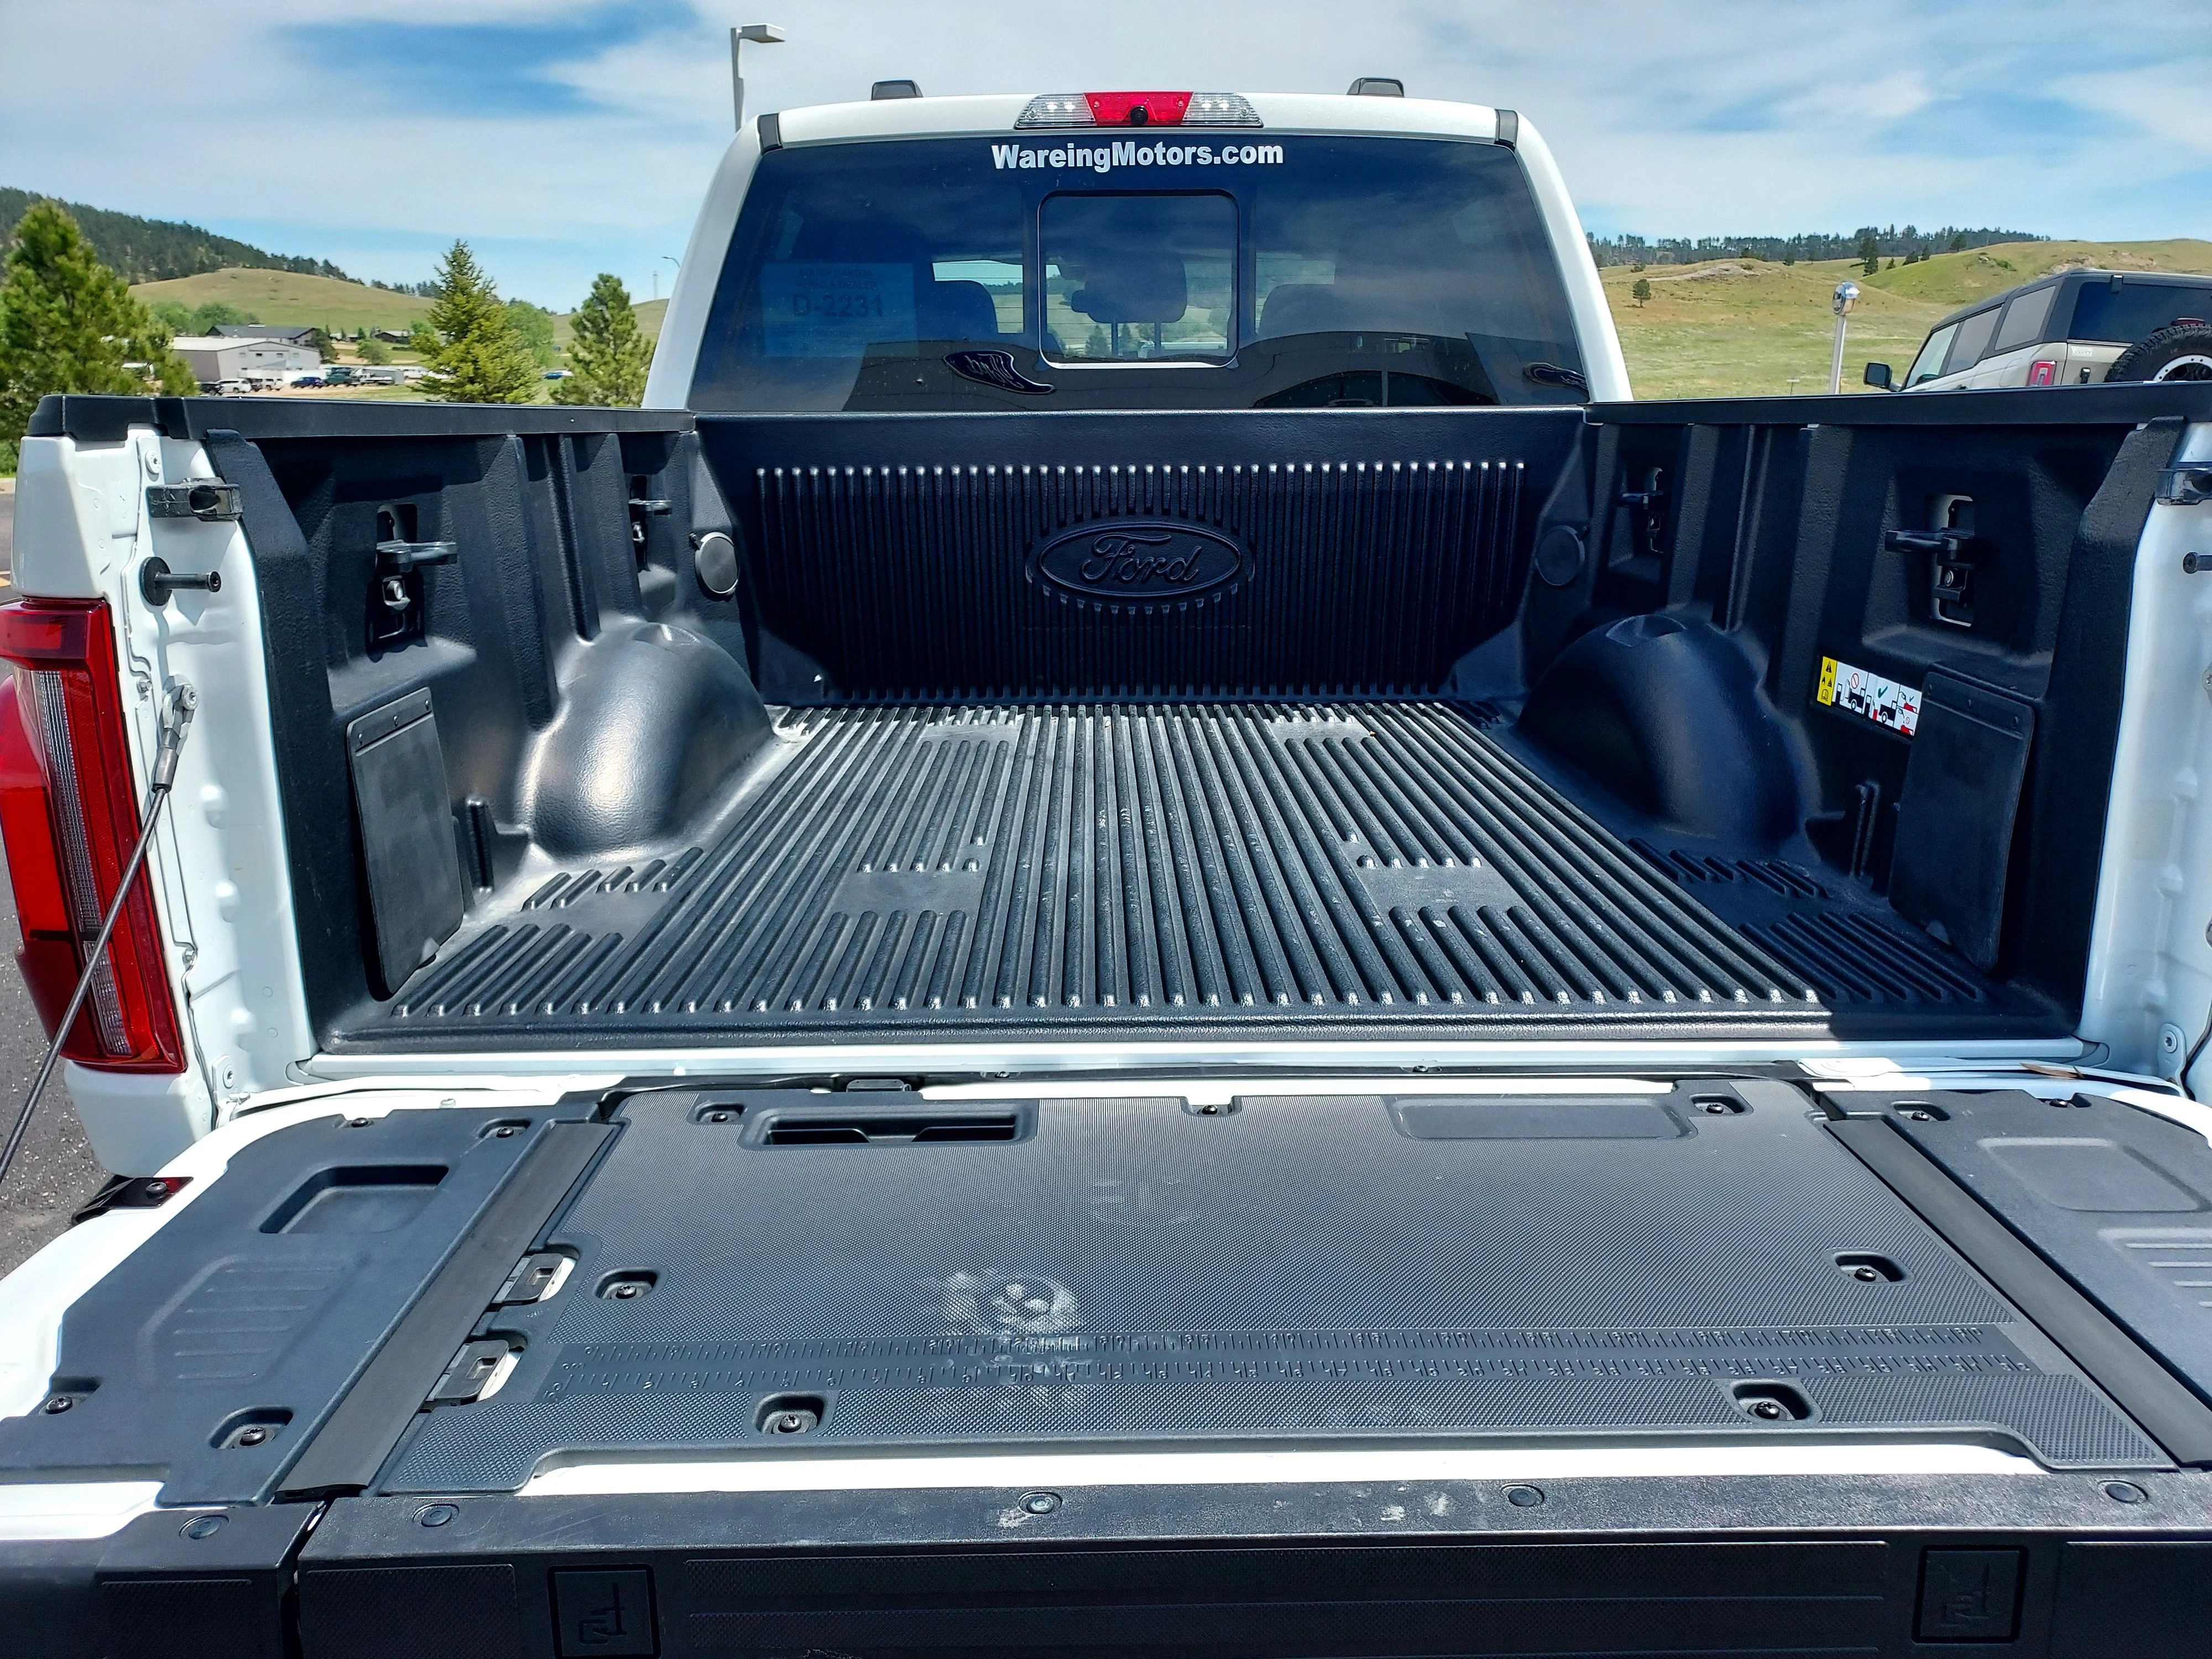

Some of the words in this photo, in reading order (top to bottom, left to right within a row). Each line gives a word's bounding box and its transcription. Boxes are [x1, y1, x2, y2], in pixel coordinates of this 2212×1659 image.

[992, 142, 1284, 173] WareingMotors.com
[792, 293, 883, 318] D-2231
[1079, 532, 1202, 584] Ford
[760, 1343, 782, 1351] 10
[929, 1339, 954, 1348] 20
[1099, 1335, 1125, 1344] 30
[1185, 1334, 1210, 1343] 35
[1441, 1332, 1467, 1341] 50
[1526, 1332, 1553, 1340] 55
[1781, 1330, 1811, 1339] 70
[1867, 1328, 1896, 1338] 75
[1010, 1373, 1034, 1382] 10
[1055, 1371, 1076, 1381] 11
[1100, 1371, 1123, 1380] 12
[1145, 1370, 1168, 1379] 13
[1190, 1370, 1214, 1379] 14
[1234, 1369, 1259, 1378] 15
[1279, 1369, 1304, 1378] 16
[1324, 1368, 1347, 1377] 17
[1369, 1368, 1395, 1377] 18
[1415, 1368, 1439, 1376] 19
[1457, 1368, 1485, 1376] 20
[1502, 1368, 1527, 1376] 21
[1548, 1367, 1576, 1376] 22
[1593, 1367, 1621, 1376] 23
[1683, 1366, 1712, 1376] 25
[1728, 1366, 1757, 1375] 26
[1772, 1366, 1799, 1374] 27
[1818, 1364, 1848, 1374] 28
[1863, 1364, 1892, 1373] 29
[1908, 1363, 1938, 1373] 30
[1954, 1363, 1983, 1372] 31
[1999, 1362, 2031, 1371] 32
